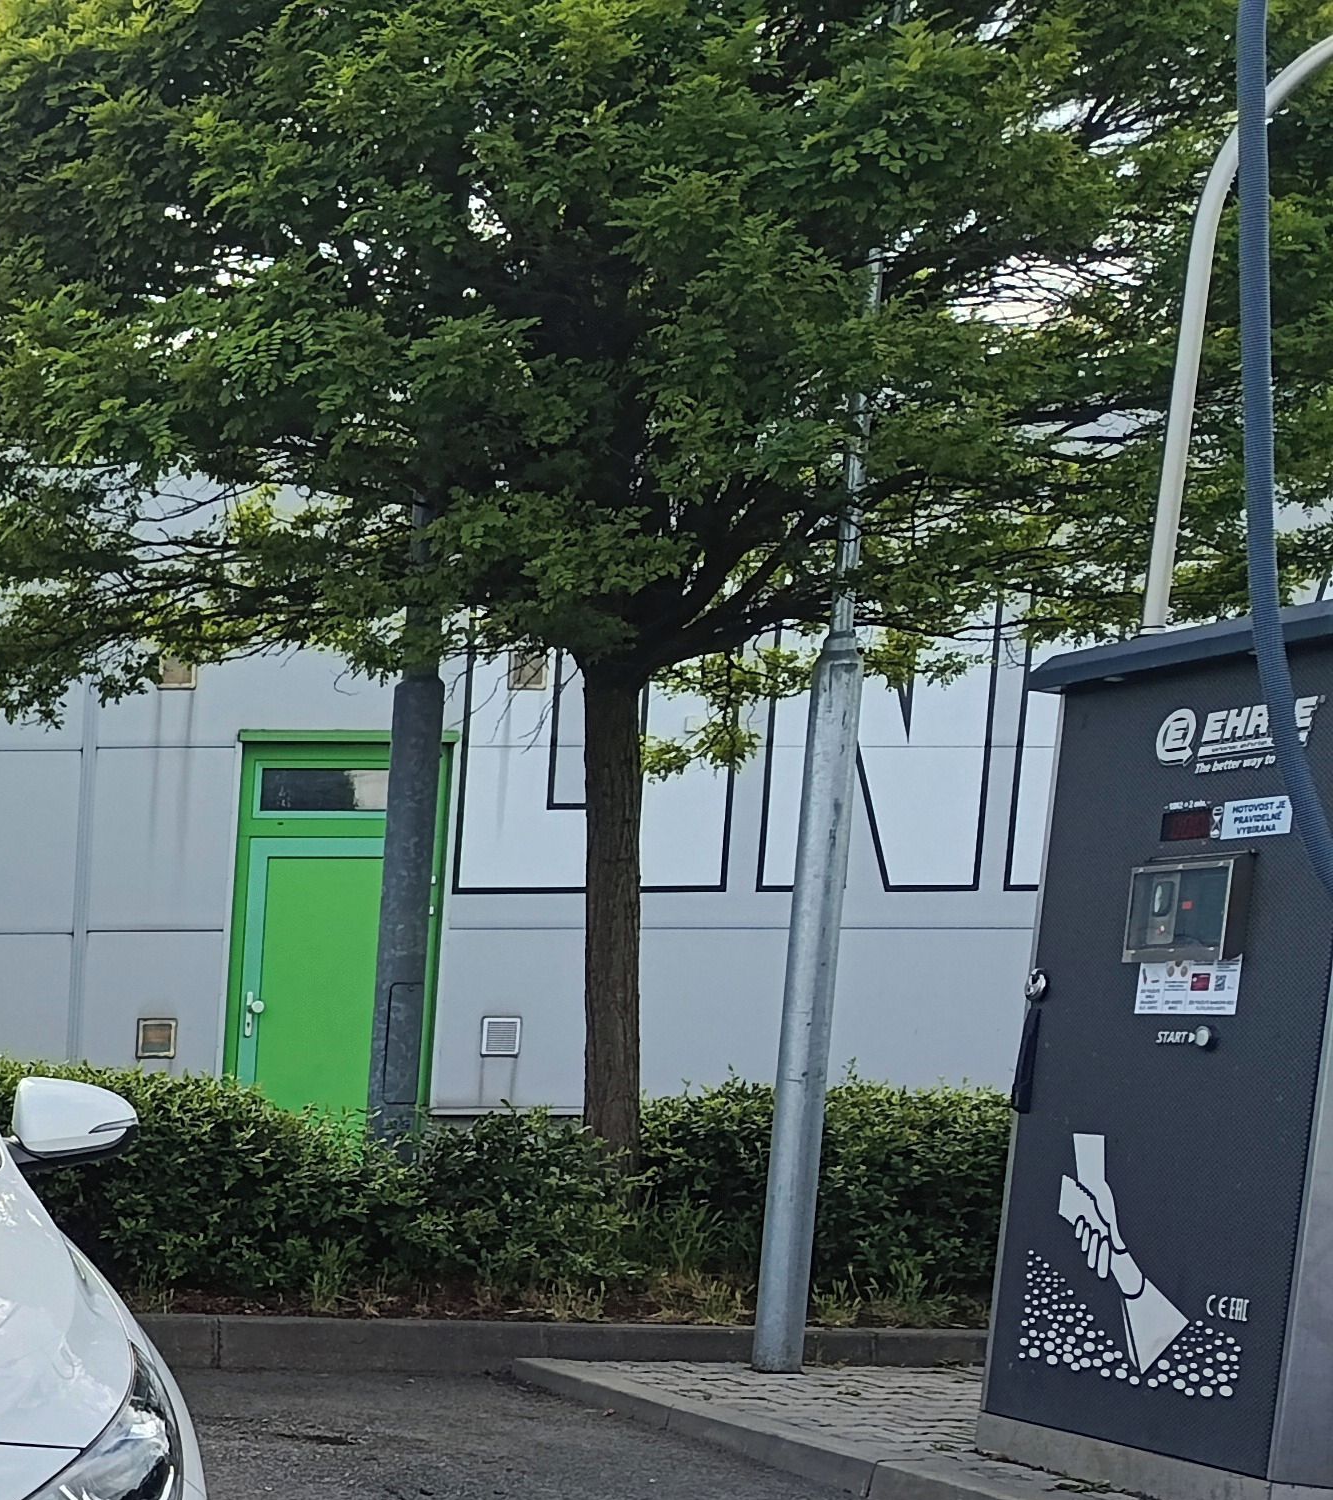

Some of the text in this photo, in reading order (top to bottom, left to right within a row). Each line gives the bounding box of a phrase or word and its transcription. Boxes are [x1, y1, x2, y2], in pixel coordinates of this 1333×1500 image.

[1201, 696, 1319, 743] EHRE
[1195, 754, 1276, 774] The better way to
[1232, 800, 1287, 815] HOTOVOST JE
[1155, 1031, 1189, 1043] START
